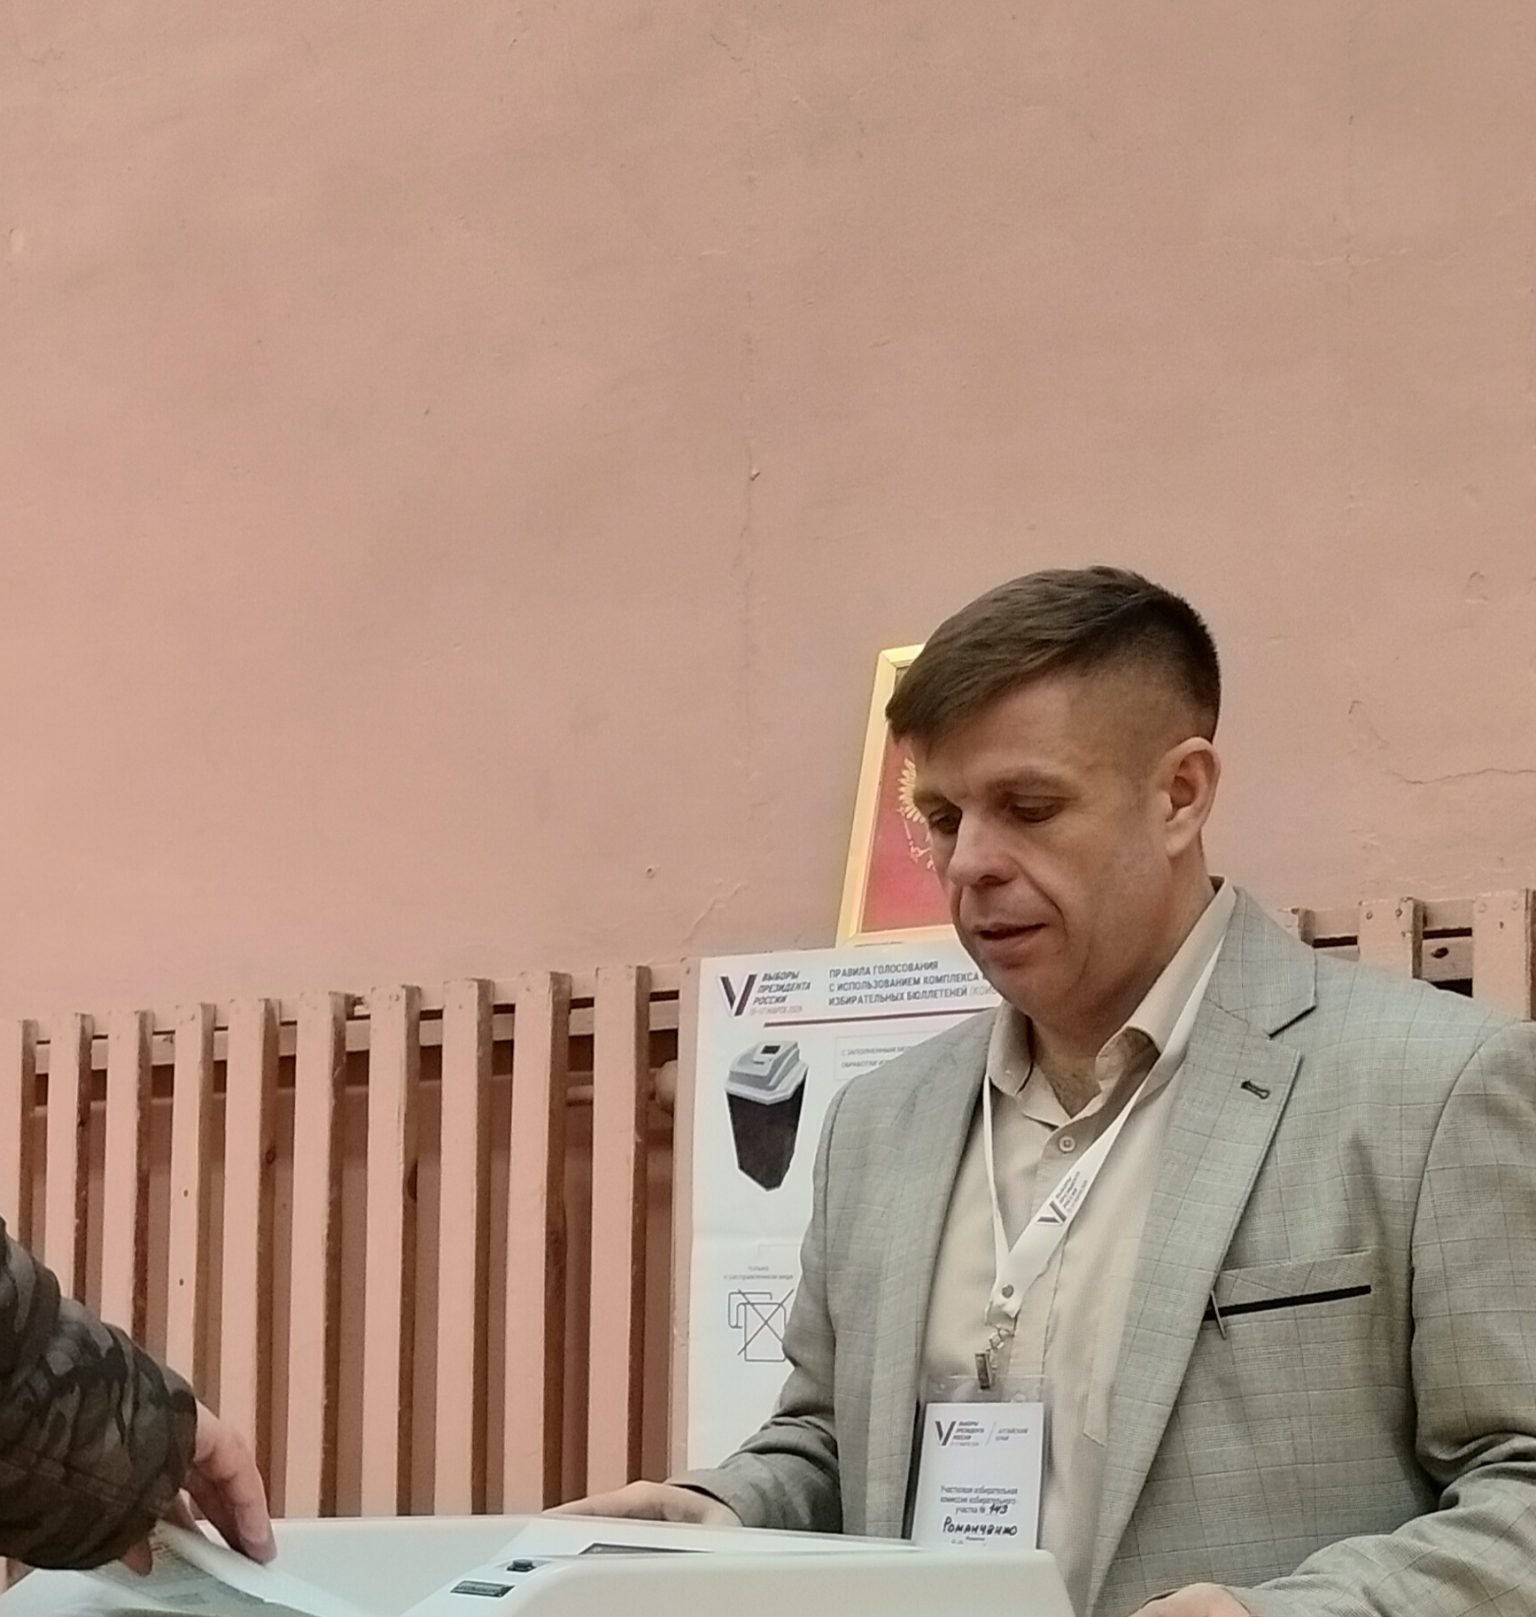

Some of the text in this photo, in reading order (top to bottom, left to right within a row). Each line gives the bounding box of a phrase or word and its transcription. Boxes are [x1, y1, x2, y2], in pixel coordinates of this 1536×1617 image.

[830, 960, 939, 979] ПРАВИЛА ГОЛОСОВАНИЯ
[828, 971, 979, 993] С ИСПОЛЬЗОВАНИЕМ КОМПЛЕКСА
[828, 991, 905, 1006] ИЗБИРАТЕЛЬНЫХ
[906, 986, 968, 1001] БЮЛЛЕТЕНЕЙ
